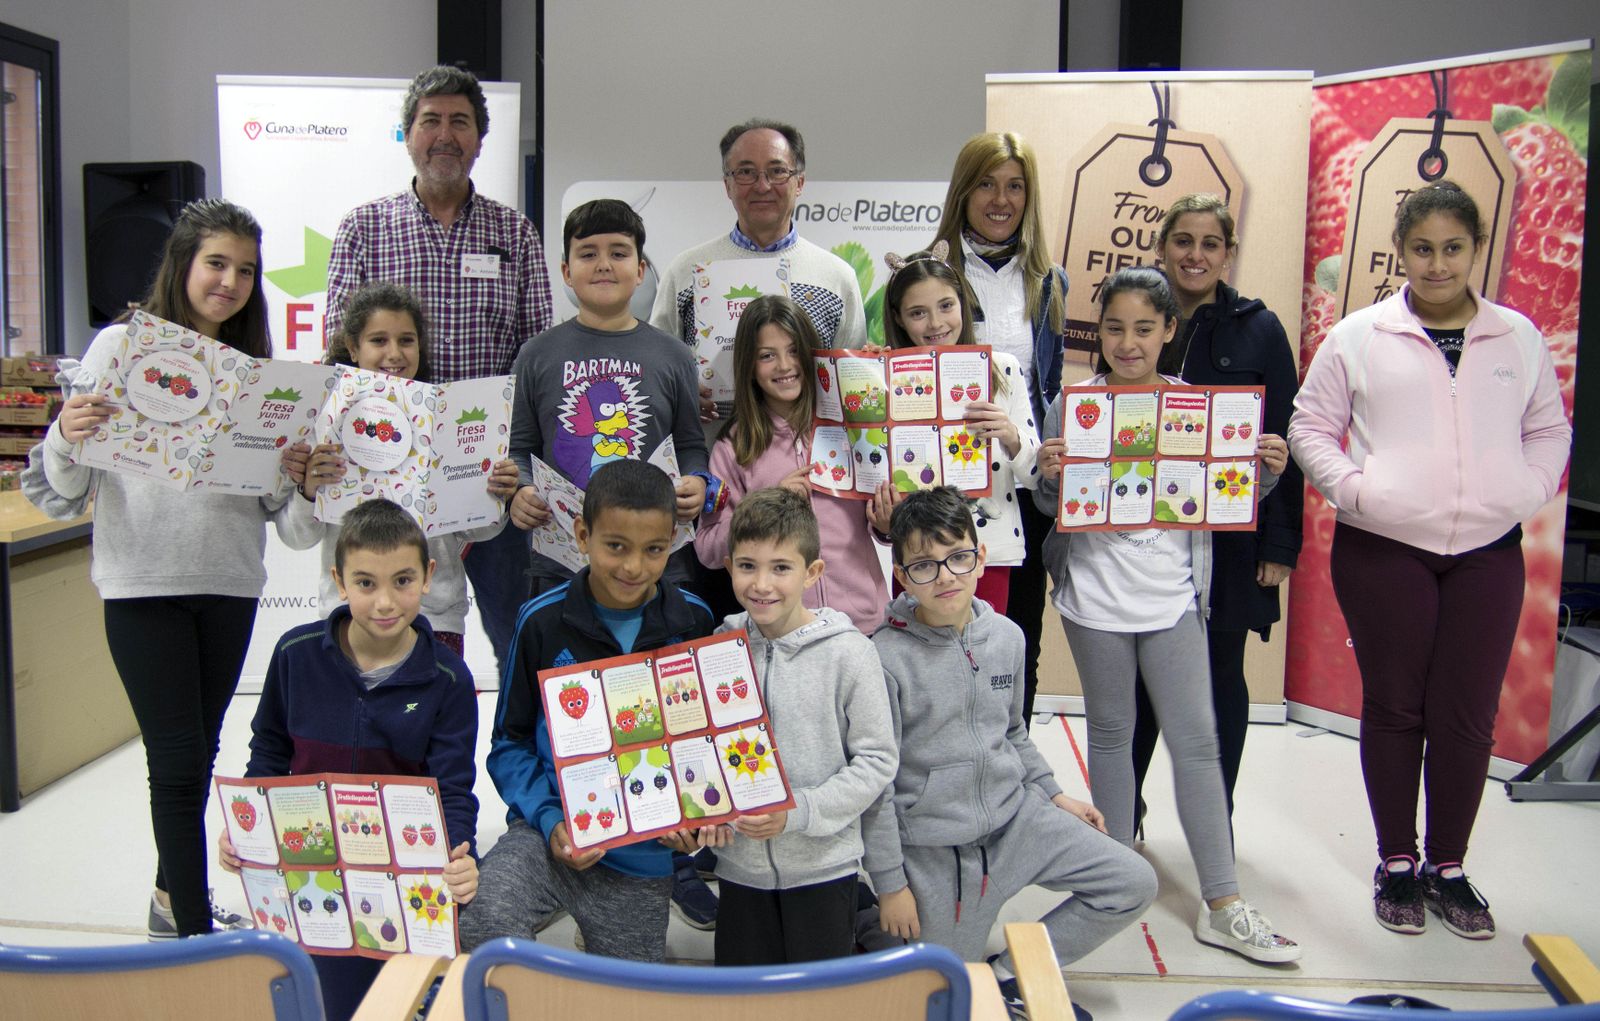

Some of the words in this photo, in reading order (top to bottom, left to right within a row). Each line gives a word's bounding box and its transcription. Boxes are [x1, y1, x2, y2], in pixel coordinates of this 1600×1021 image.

[1111, 226, 1156, 251] OU
[1369, 251, 1406, 277] FIE
[727, 301, 750, 311] Fre
[562, 358, 641, 387] BARTMAN
[261, 400, 296, 413] Fresa
[257, 411, 291, 420] yunan
[262, 420, 276, 428] do
[457, 424, 486, 437] Fresa
[457, 434, 485, 447] yunan
[464, 445, 475, 454] do
